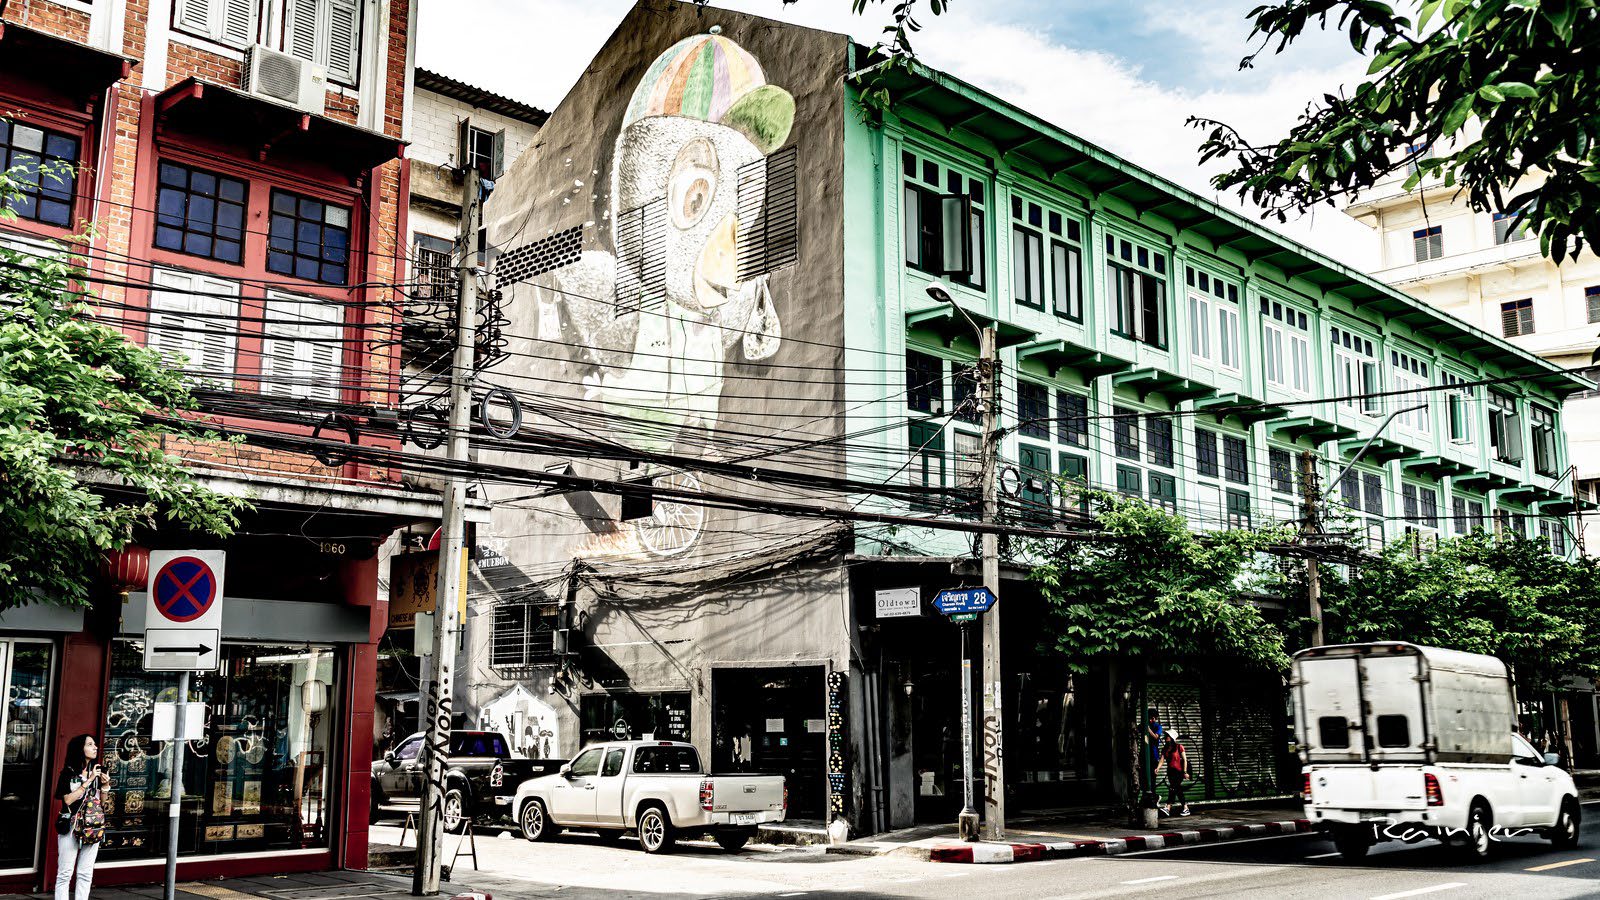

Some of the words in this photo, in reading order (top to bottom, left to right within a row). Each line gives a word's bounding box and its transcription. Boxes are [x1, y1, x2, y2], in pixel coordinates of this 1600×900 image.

[320, 541, 346, 554] 1060
[877, 599, 916, 608] Oldtown
[973, 591, 987, 605] 28
